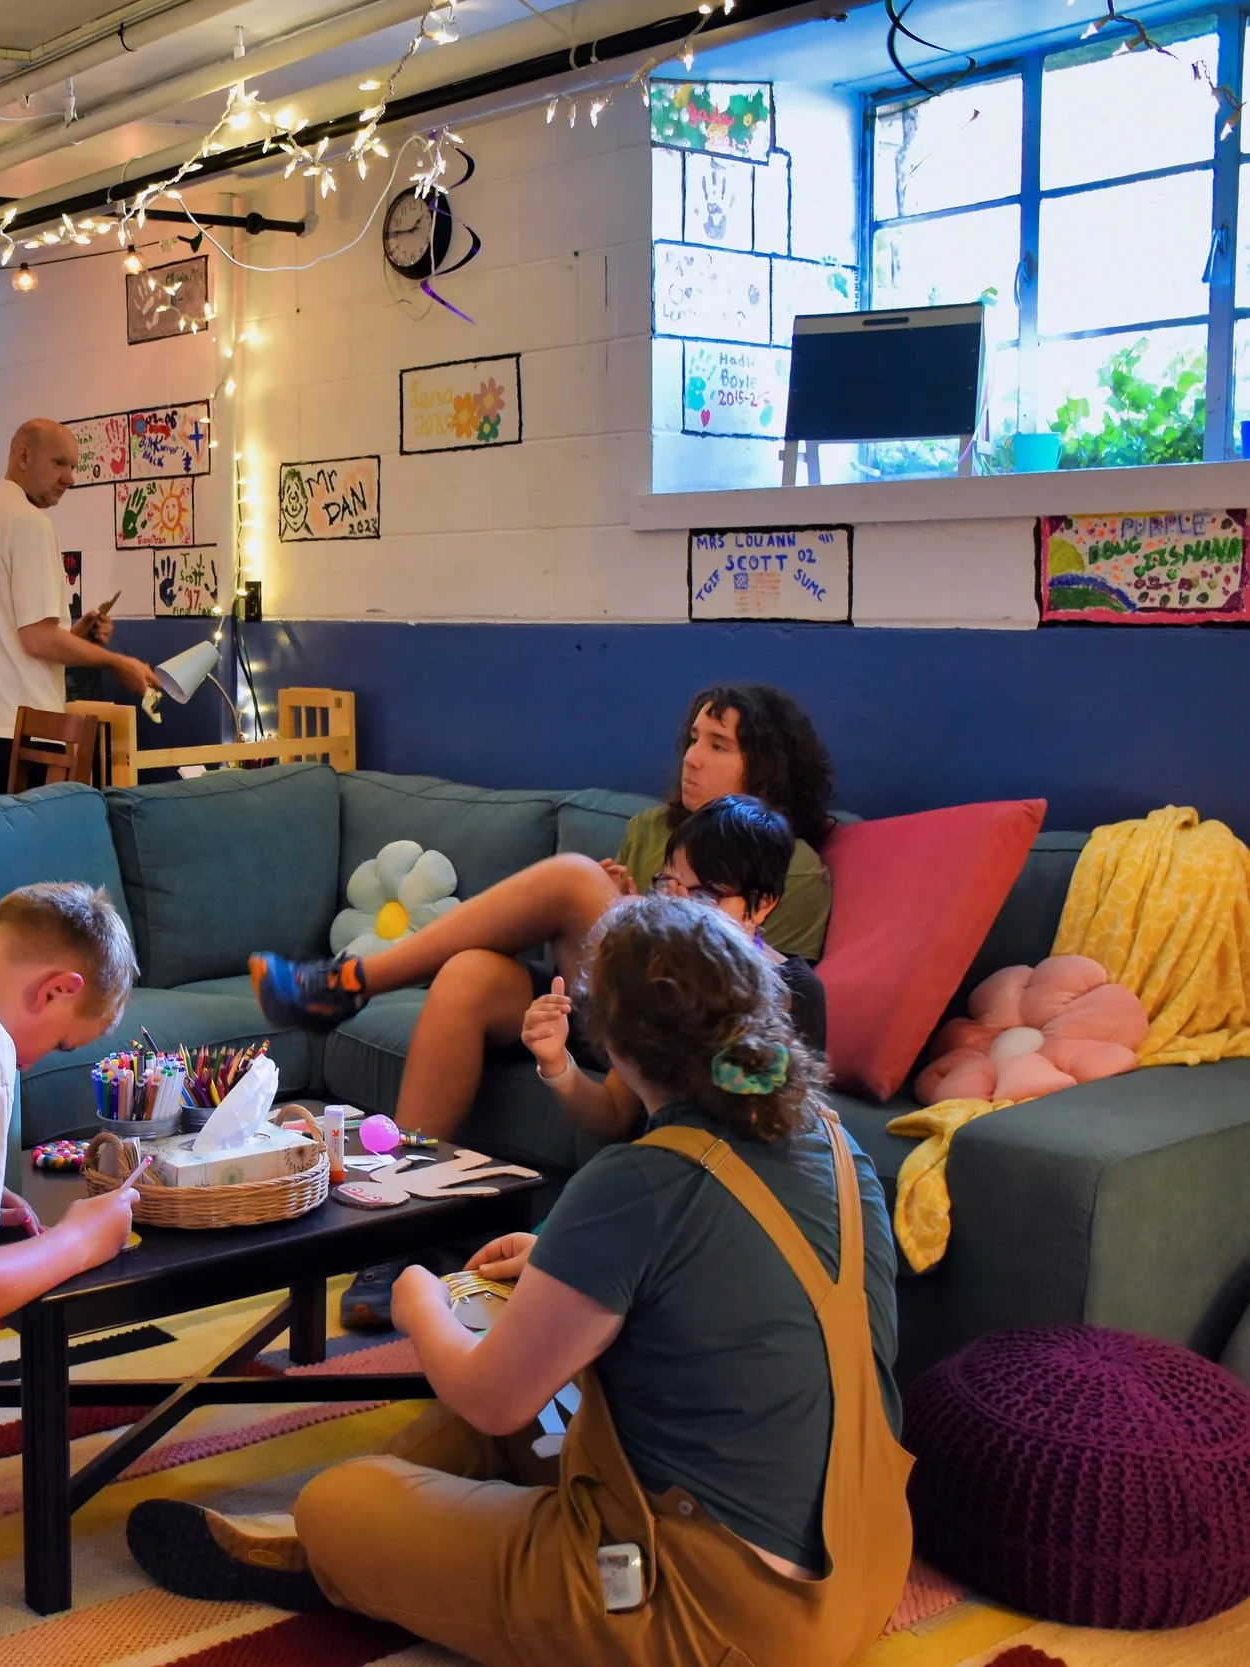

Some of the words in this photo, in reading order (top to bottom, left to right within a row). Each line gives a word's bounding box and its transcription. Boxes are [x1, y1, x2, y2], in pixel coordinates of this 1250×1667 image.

[720, 352, 756, 368] Hadl
[721, 369, 757, 389] Boyle
[305, 469, 337, 498] Mr
[322, 481, 367, 526] DAN
[1121, 512, 1210, 539] PURPLE
[697, 535, 725, 550] MRS
[818, 533, 834, 544] 911
[1088, 536, 1142, 565] DOUG
[725, 554, 788, 571] SCOTT
[798, 549, 817, 564] 02
[695, 569, 722, 602] TGIF
[793, 568, 826, 602] SUMC
